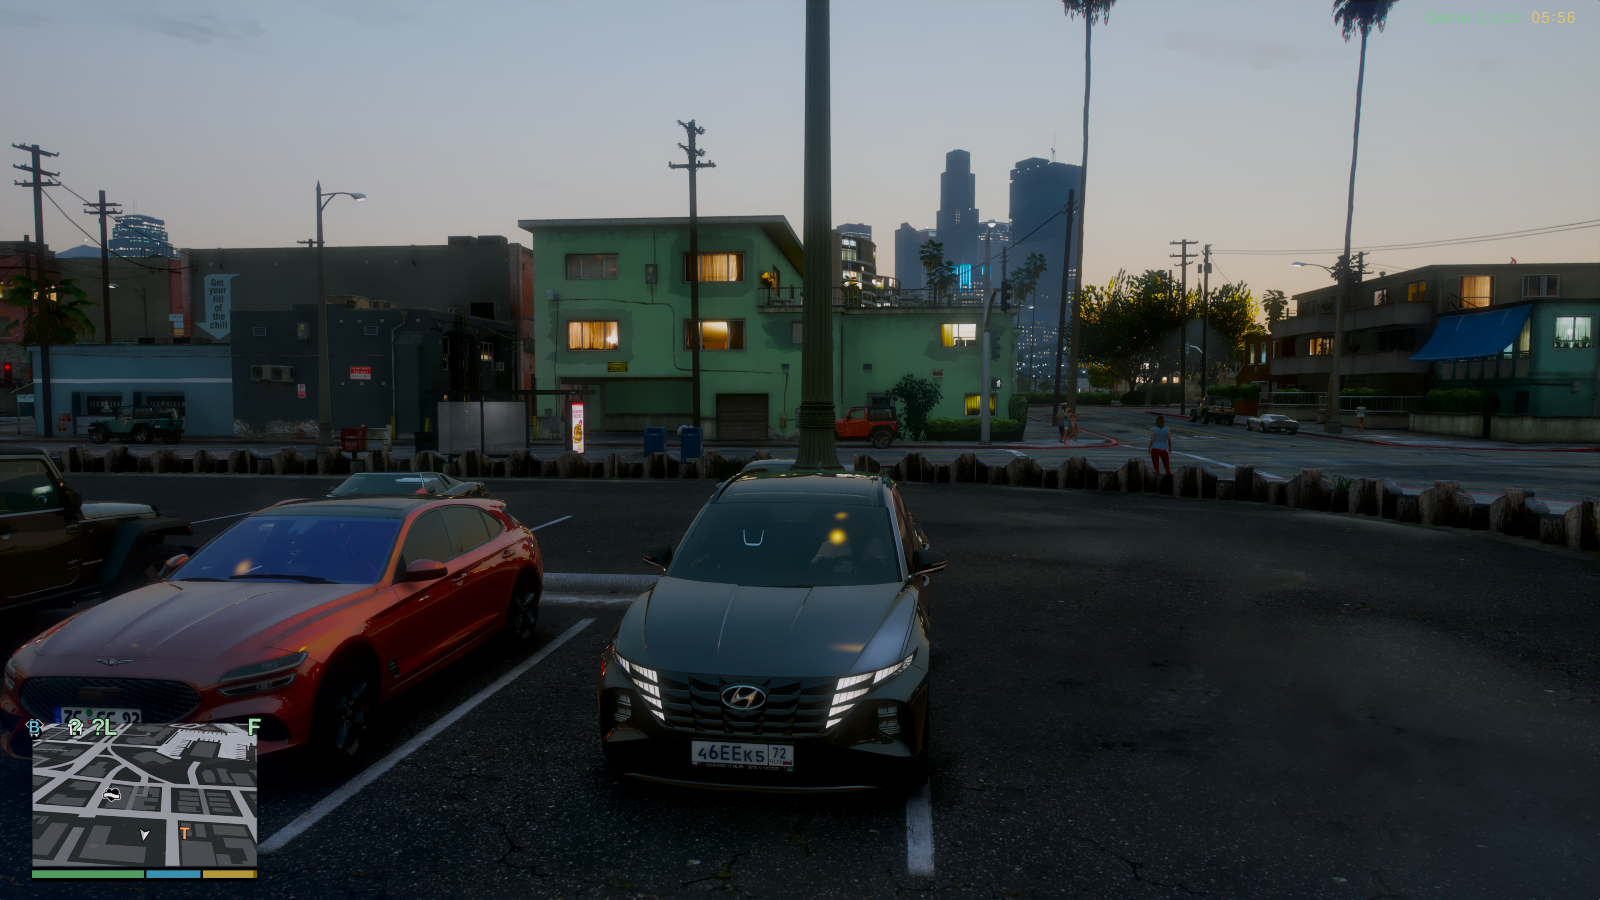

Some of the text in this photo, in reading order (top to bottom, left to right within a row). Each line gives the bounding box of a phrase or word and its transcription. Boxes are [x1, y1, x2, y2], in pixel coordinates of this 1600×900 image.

[209, 287, 226, 295] your
[698, 745, 786, 762] 46EEK5 72
